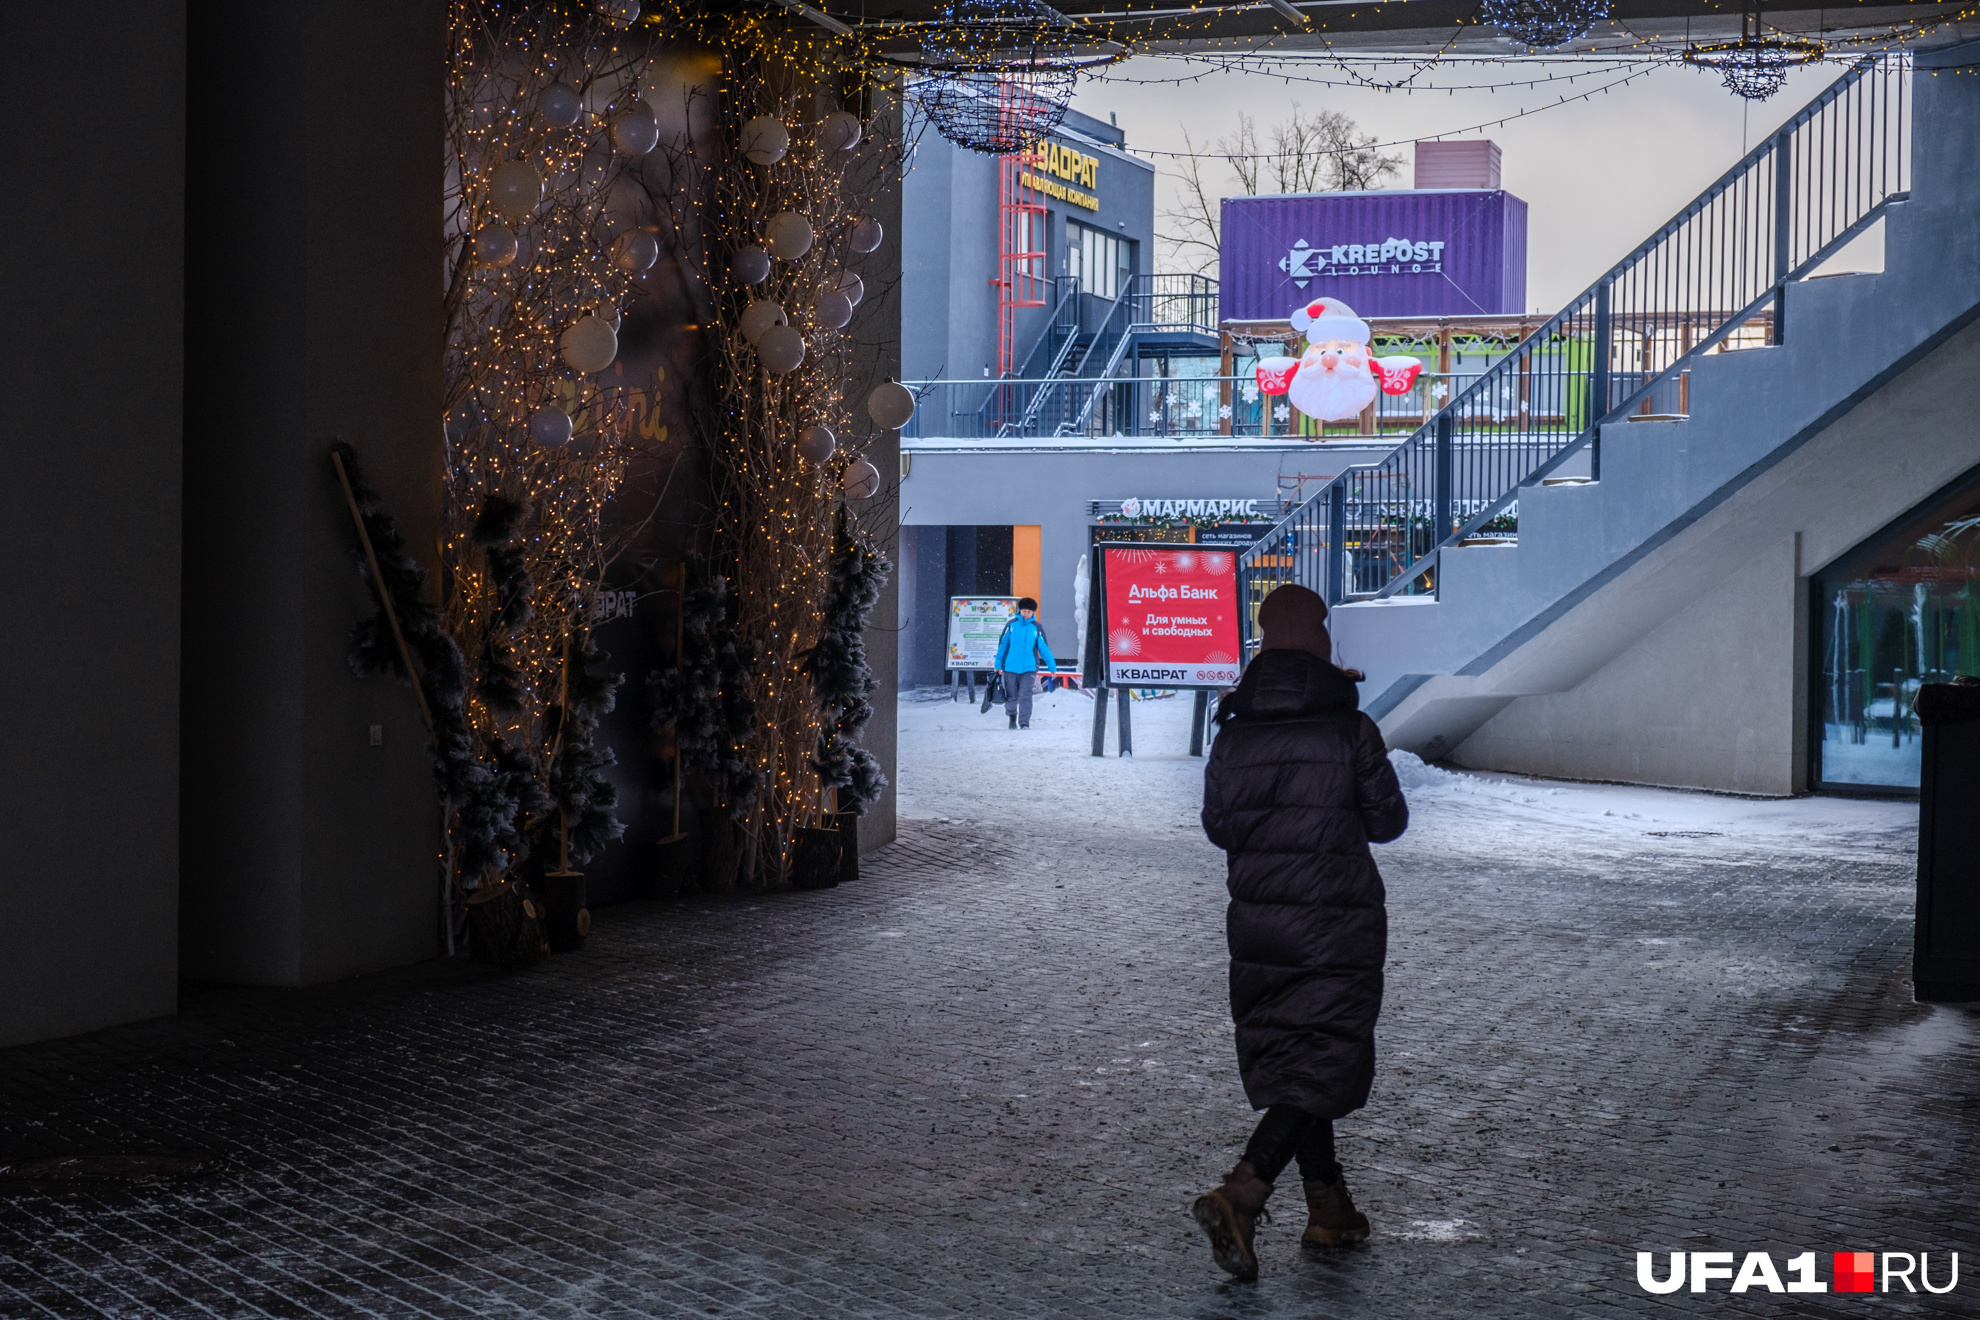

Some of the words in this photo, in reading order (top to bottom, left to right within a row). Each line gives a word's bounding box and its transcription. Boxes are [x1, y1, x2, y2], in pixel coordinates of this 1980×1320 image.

[1067, 187, 1099, 212] КОМПАНИЯ
[1332, 241, 1445, 265] KREPOST
[1332, 263, 1442, 276] LOUNGE
[1142, 499, 1258, 517] МАРМАРИС
[1128, 584, 1178, 602] Альфа
[1180, 585, 1218, 600] Банк
[1146, 614, 1169, 625] Для
[1170, 616, 1208, 625] умных
[1142, 627, 1150, 635] и
[1151, 626, 1213, 637] свободных
